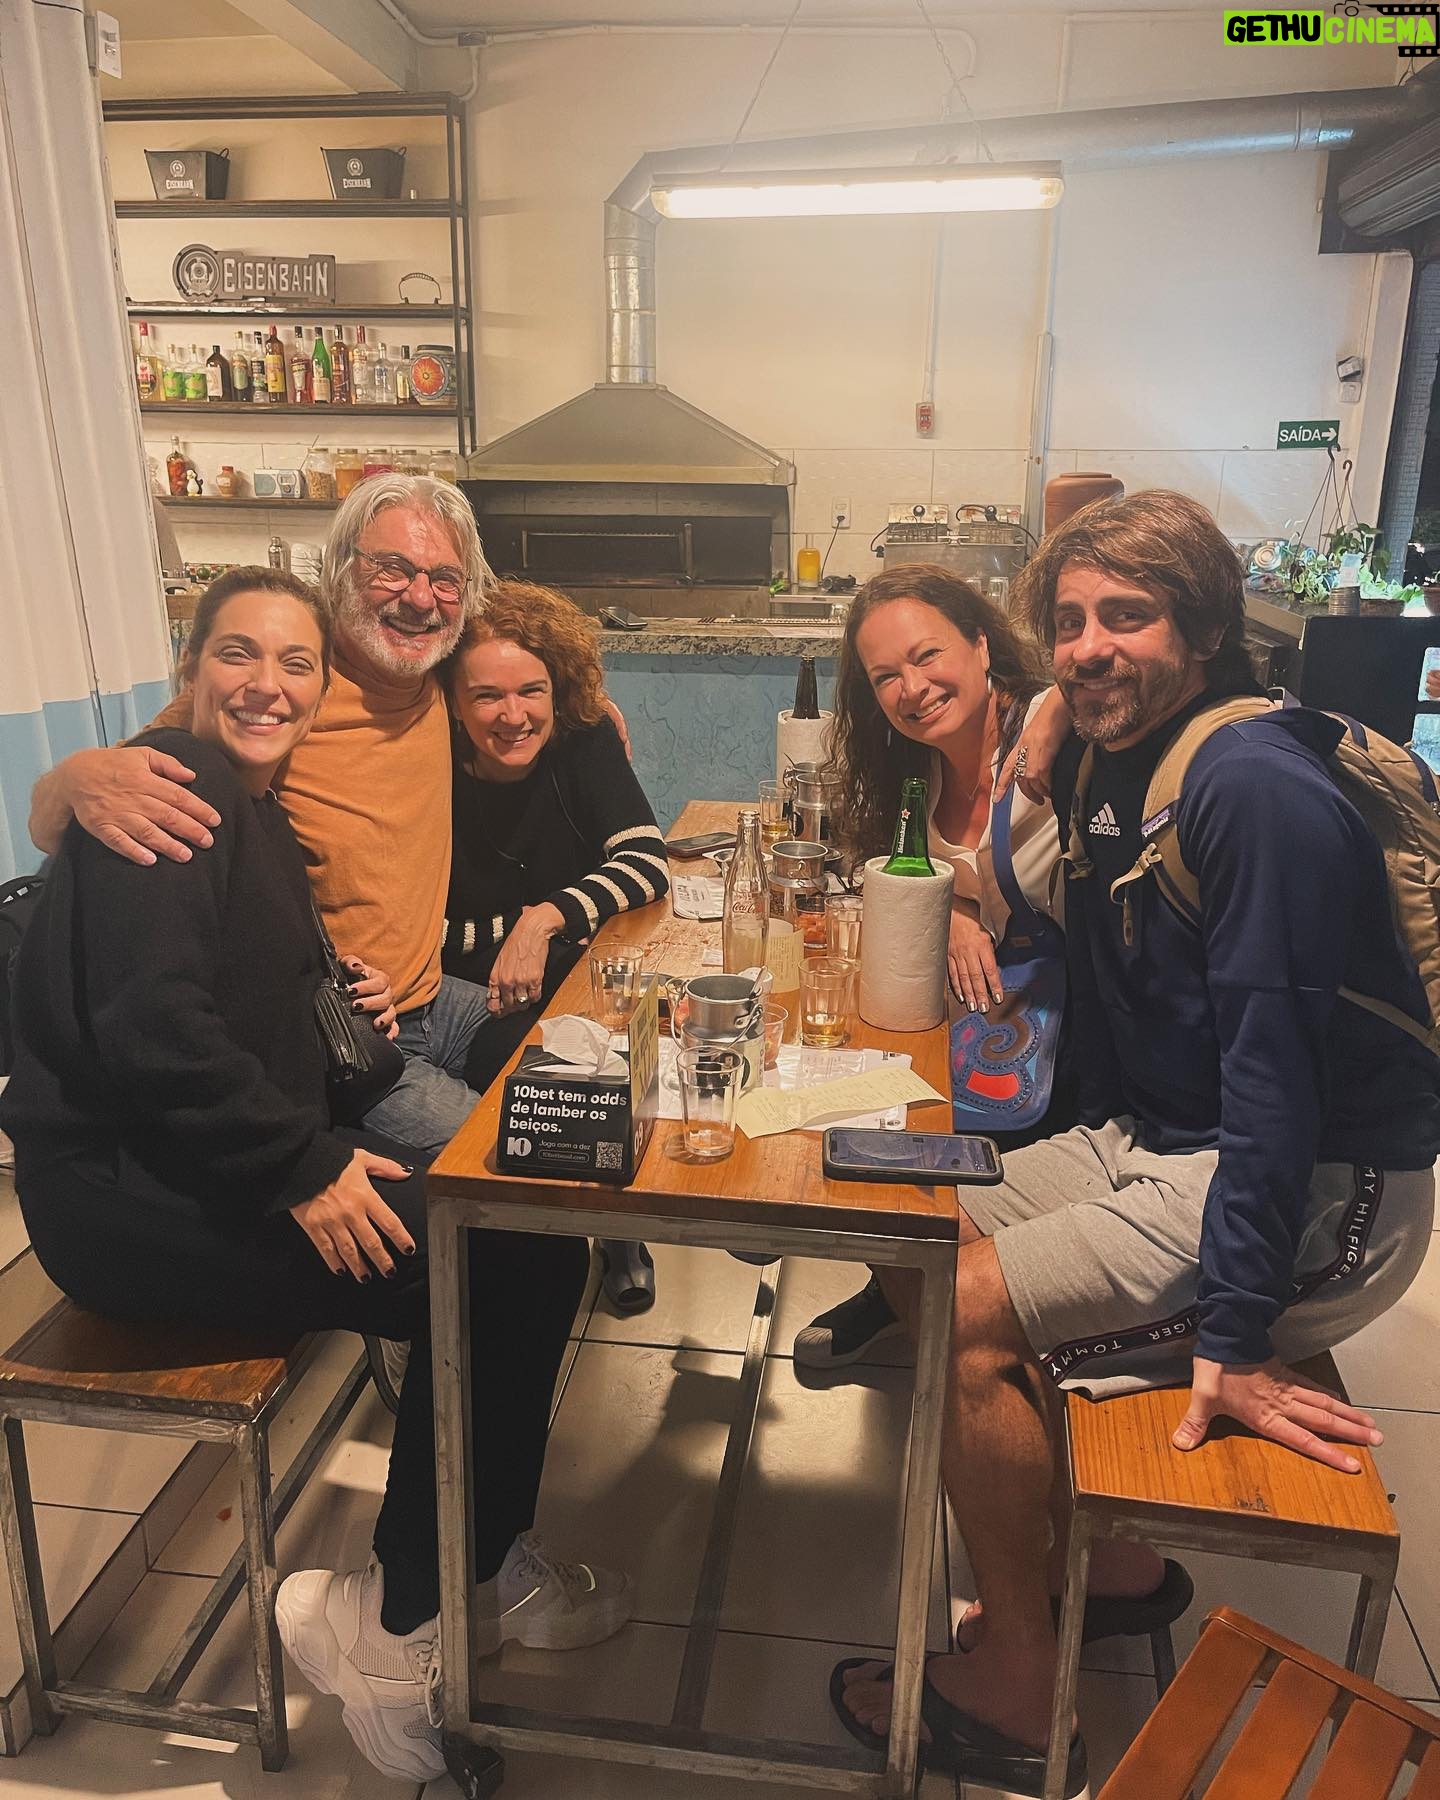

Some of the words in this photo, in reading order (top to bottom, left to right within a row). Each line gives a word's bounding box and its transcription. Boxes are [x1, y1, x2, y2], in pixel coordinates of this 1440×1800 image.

[223, 258, 328, 297] EISENBAHN
[1279, 425, 1321, 442] SAÍDA
[1088, 822, 1121, 837] adidas
[513, 1085, 555, 1100] 10bet
[558, 1089, 587, 1103] tem
[590, 1092, 627, 1106] odds
[510, 1100, 530, 1114] de
[533, 1102, 587, 1119] lamber
[589, 1110, 608, 1121] os
[509, 1116, 562, 1134] beiços.
[1329, 1202, 1369, 1281] HILFIGER
[1051, 1339, 1122, 1377] TOMMY
